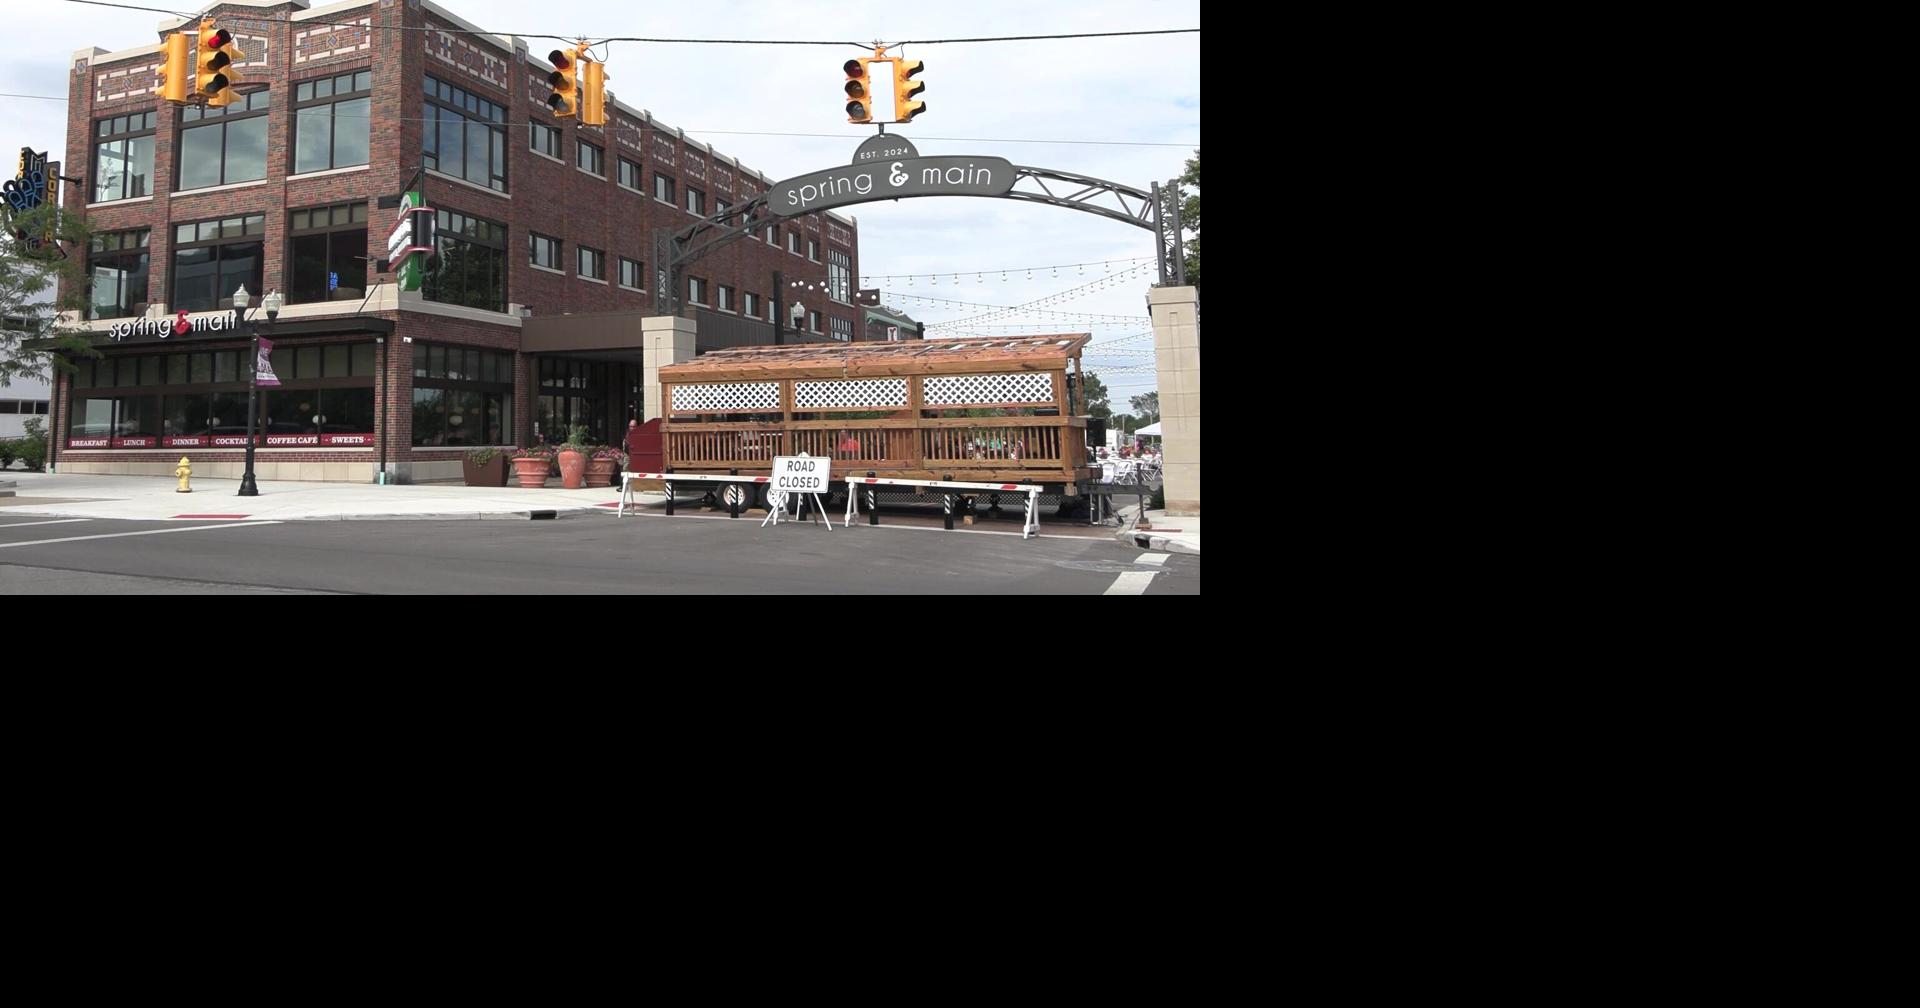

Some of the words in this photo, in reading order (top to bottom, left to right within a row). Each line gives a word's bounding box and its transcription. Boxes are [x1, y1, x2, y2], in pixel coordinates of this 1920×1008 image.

[860, 151, 880, 160] EST.
[884, 147, 908, 157] 2024
[788, 173, 872, 207] spring
[889, 161, 909, 187] &
[922, 163, 991, 185] main
[109, 316, 171, 341] spring
[174, 310, 192, 335] &
[172, 438, 200, 446] DINNER
[215, 437, 256, 445] COCKTAI
[267, 437, 297, 445] COFFEE
[297, 435, 319, 444] CAFÉ
[331, 436, 365, 444] SWEETS
[787, 460, 816, 472] ROAD
[779, 476, 820, 489] CLOSED
